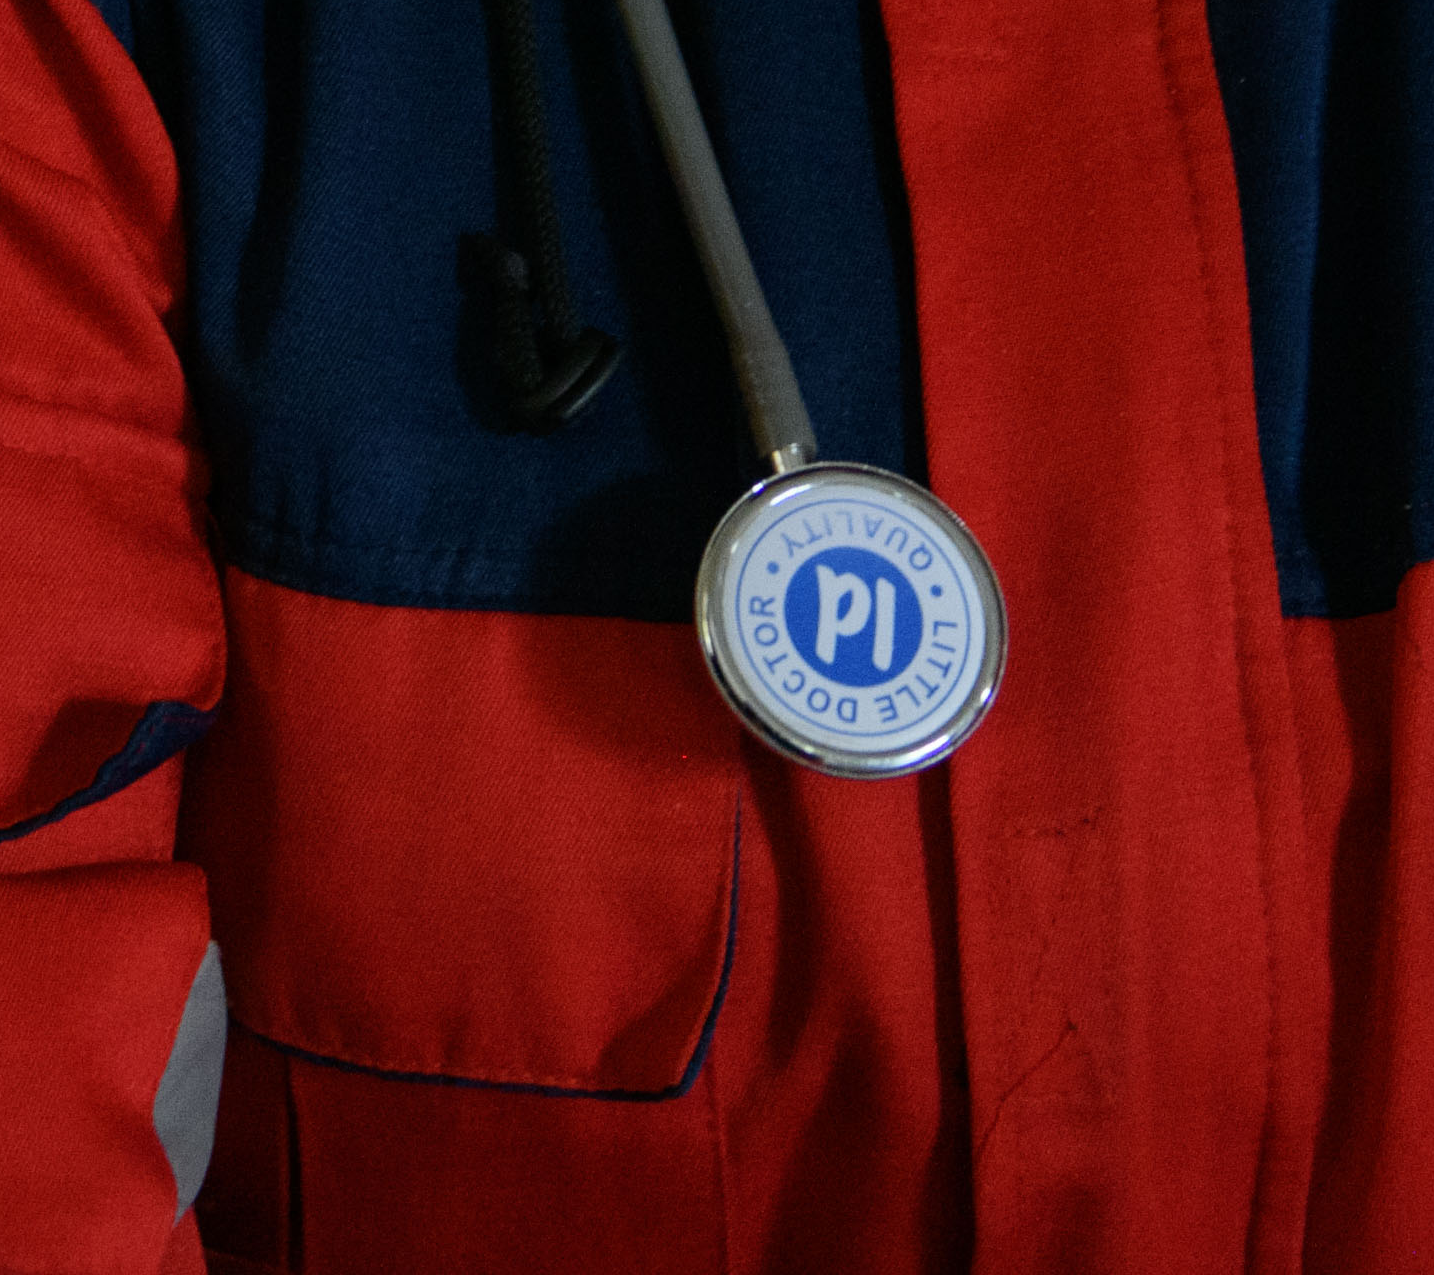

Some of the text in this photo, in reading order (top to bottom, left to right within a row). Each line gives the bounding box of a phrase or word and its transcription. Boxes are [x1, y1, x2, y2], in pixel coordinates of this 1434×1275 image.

[782, 511, 933, 571] QUALITY
[750, 595, 958, 723] LITTLE DOCTOR
